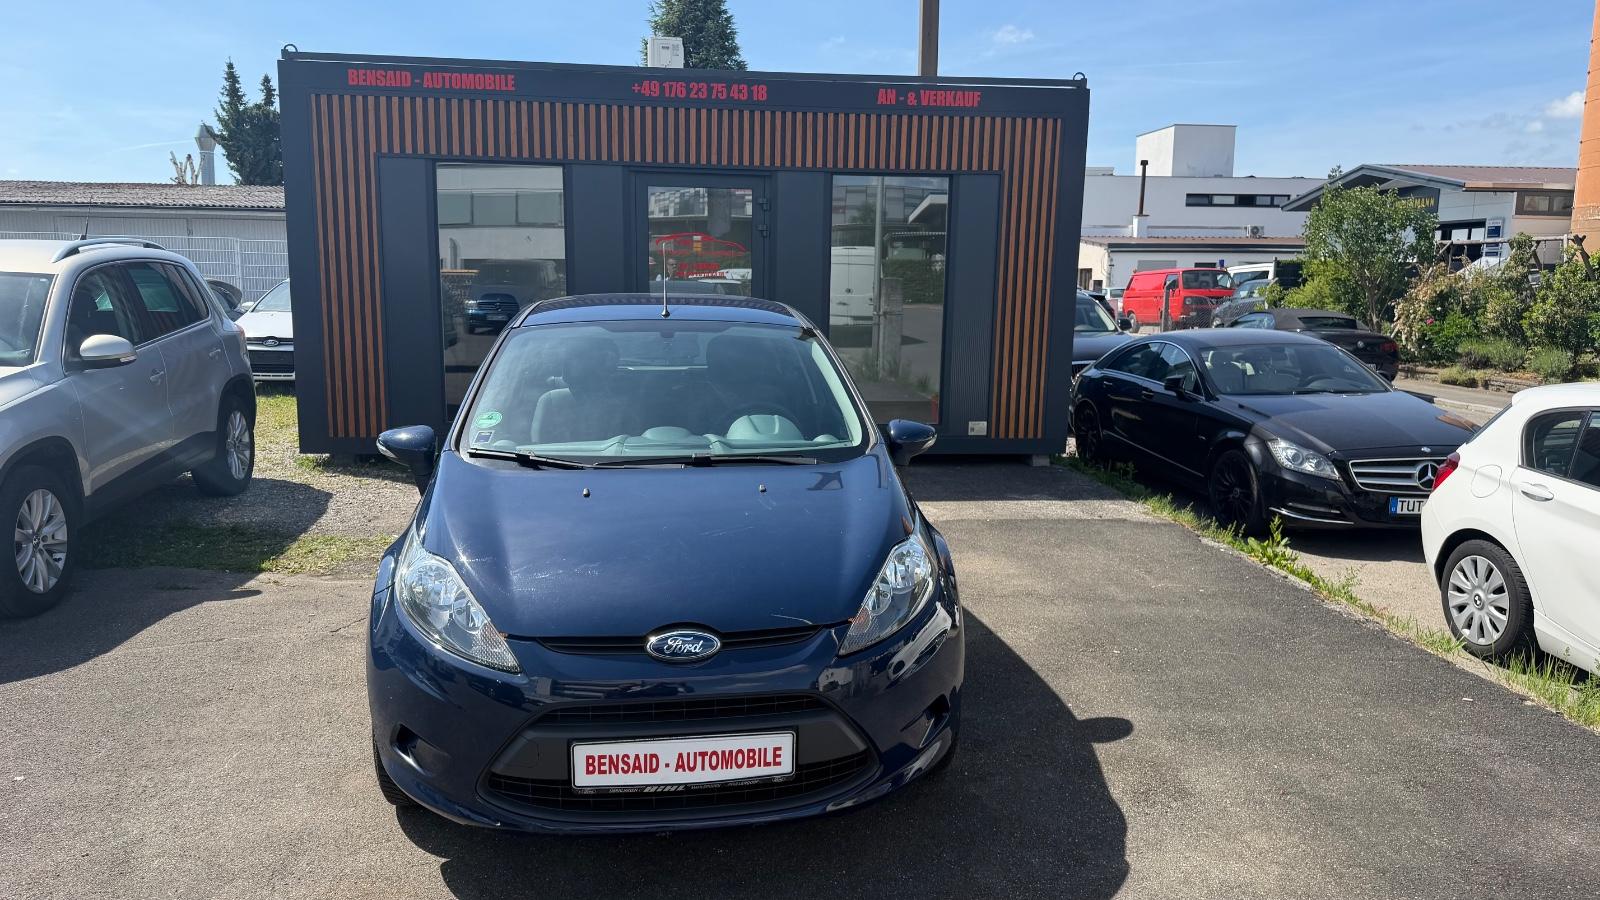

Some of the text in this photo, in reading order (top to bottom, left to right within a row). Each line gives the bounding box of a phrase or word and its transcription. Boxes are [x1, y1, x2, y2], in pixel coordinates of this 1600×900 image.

[347, 68, 411, 87] BENSAID
[423, 72, 516, 91] AUTOMOBILE
[632, 80, 767, 101] +49 176 23 75 43 18
[877, 88, 896, 105] AN
[907, 92, 917, 106] &
[920, 90, 982, 107] VERKAUF
[664, 636, 704, 654] Ford
[585, 753, 660, 776] BENSAID
[674, 746, 783, 773] AUTOMOBILE
